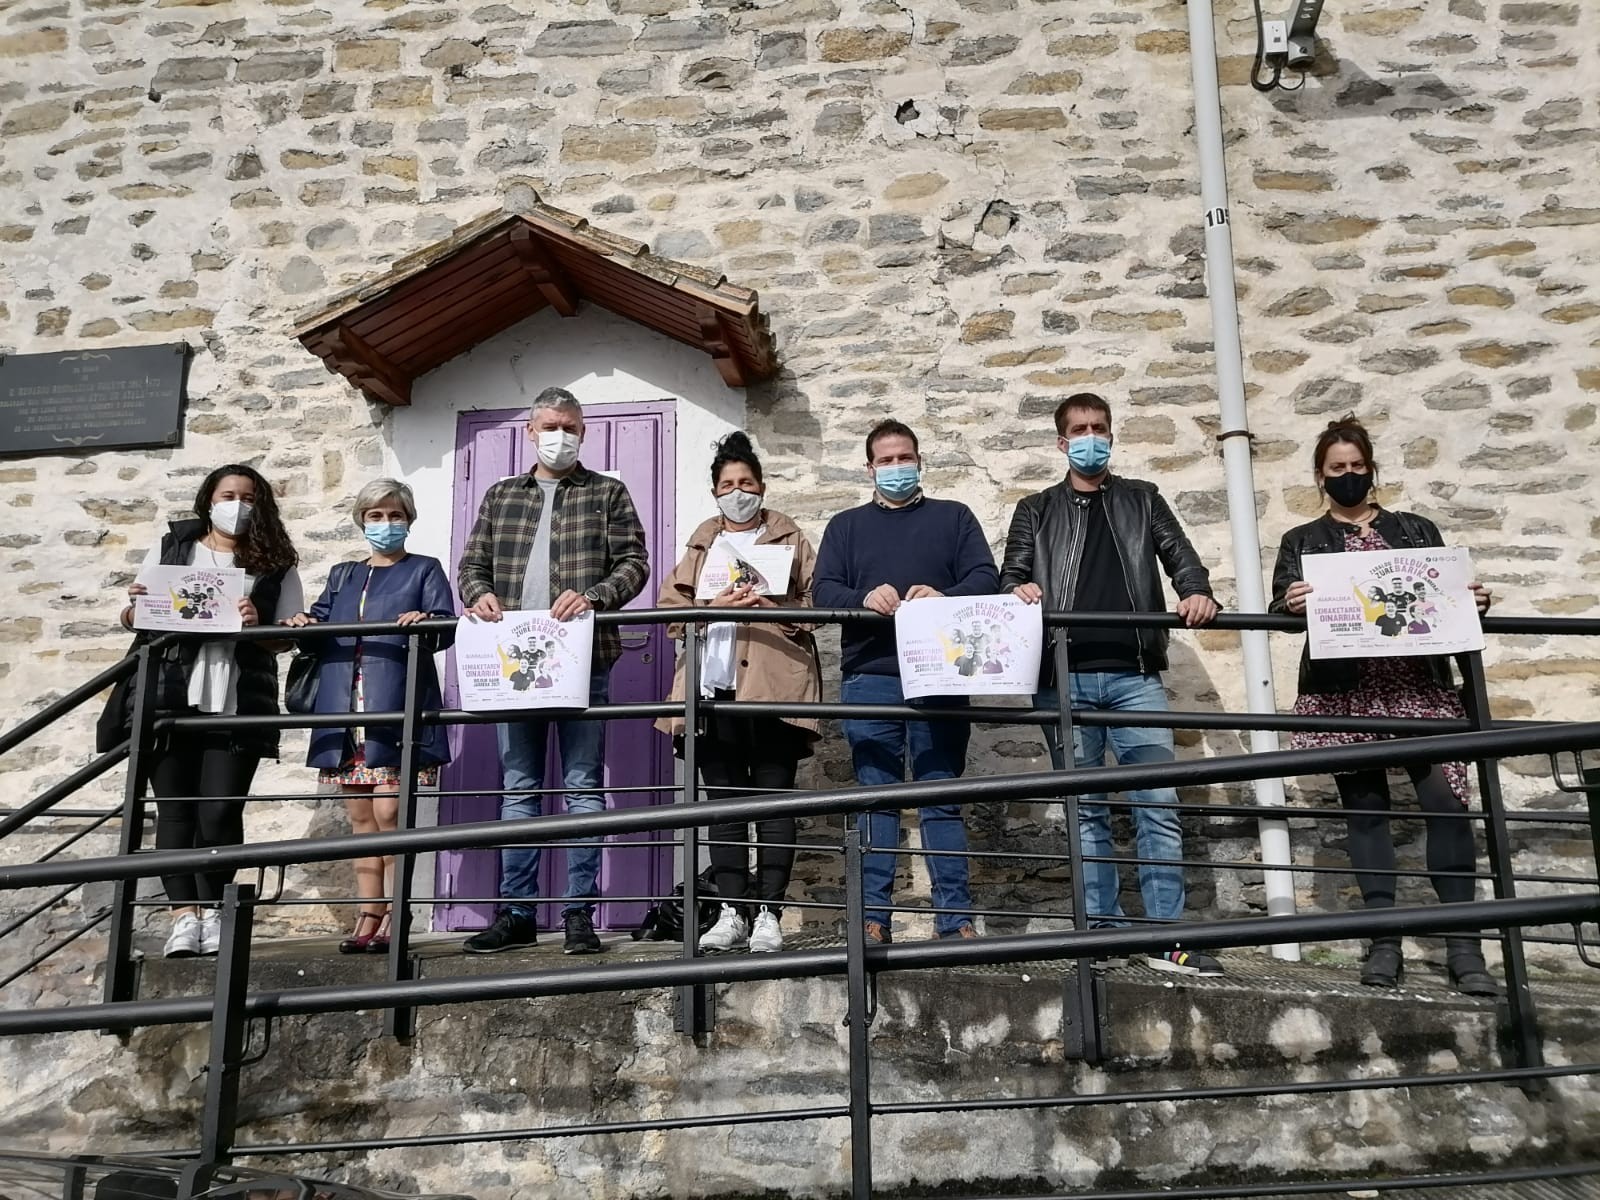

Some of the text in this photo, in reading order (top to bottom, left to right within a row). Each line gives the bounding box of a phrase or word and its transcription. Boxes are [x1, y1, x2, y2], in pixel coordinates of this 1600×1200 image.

[1394, 557, 1429, 571] BELDUR
[1375, 566, 1395, 579] ZURE
[1394, 565, 1425, 577] BARIK
